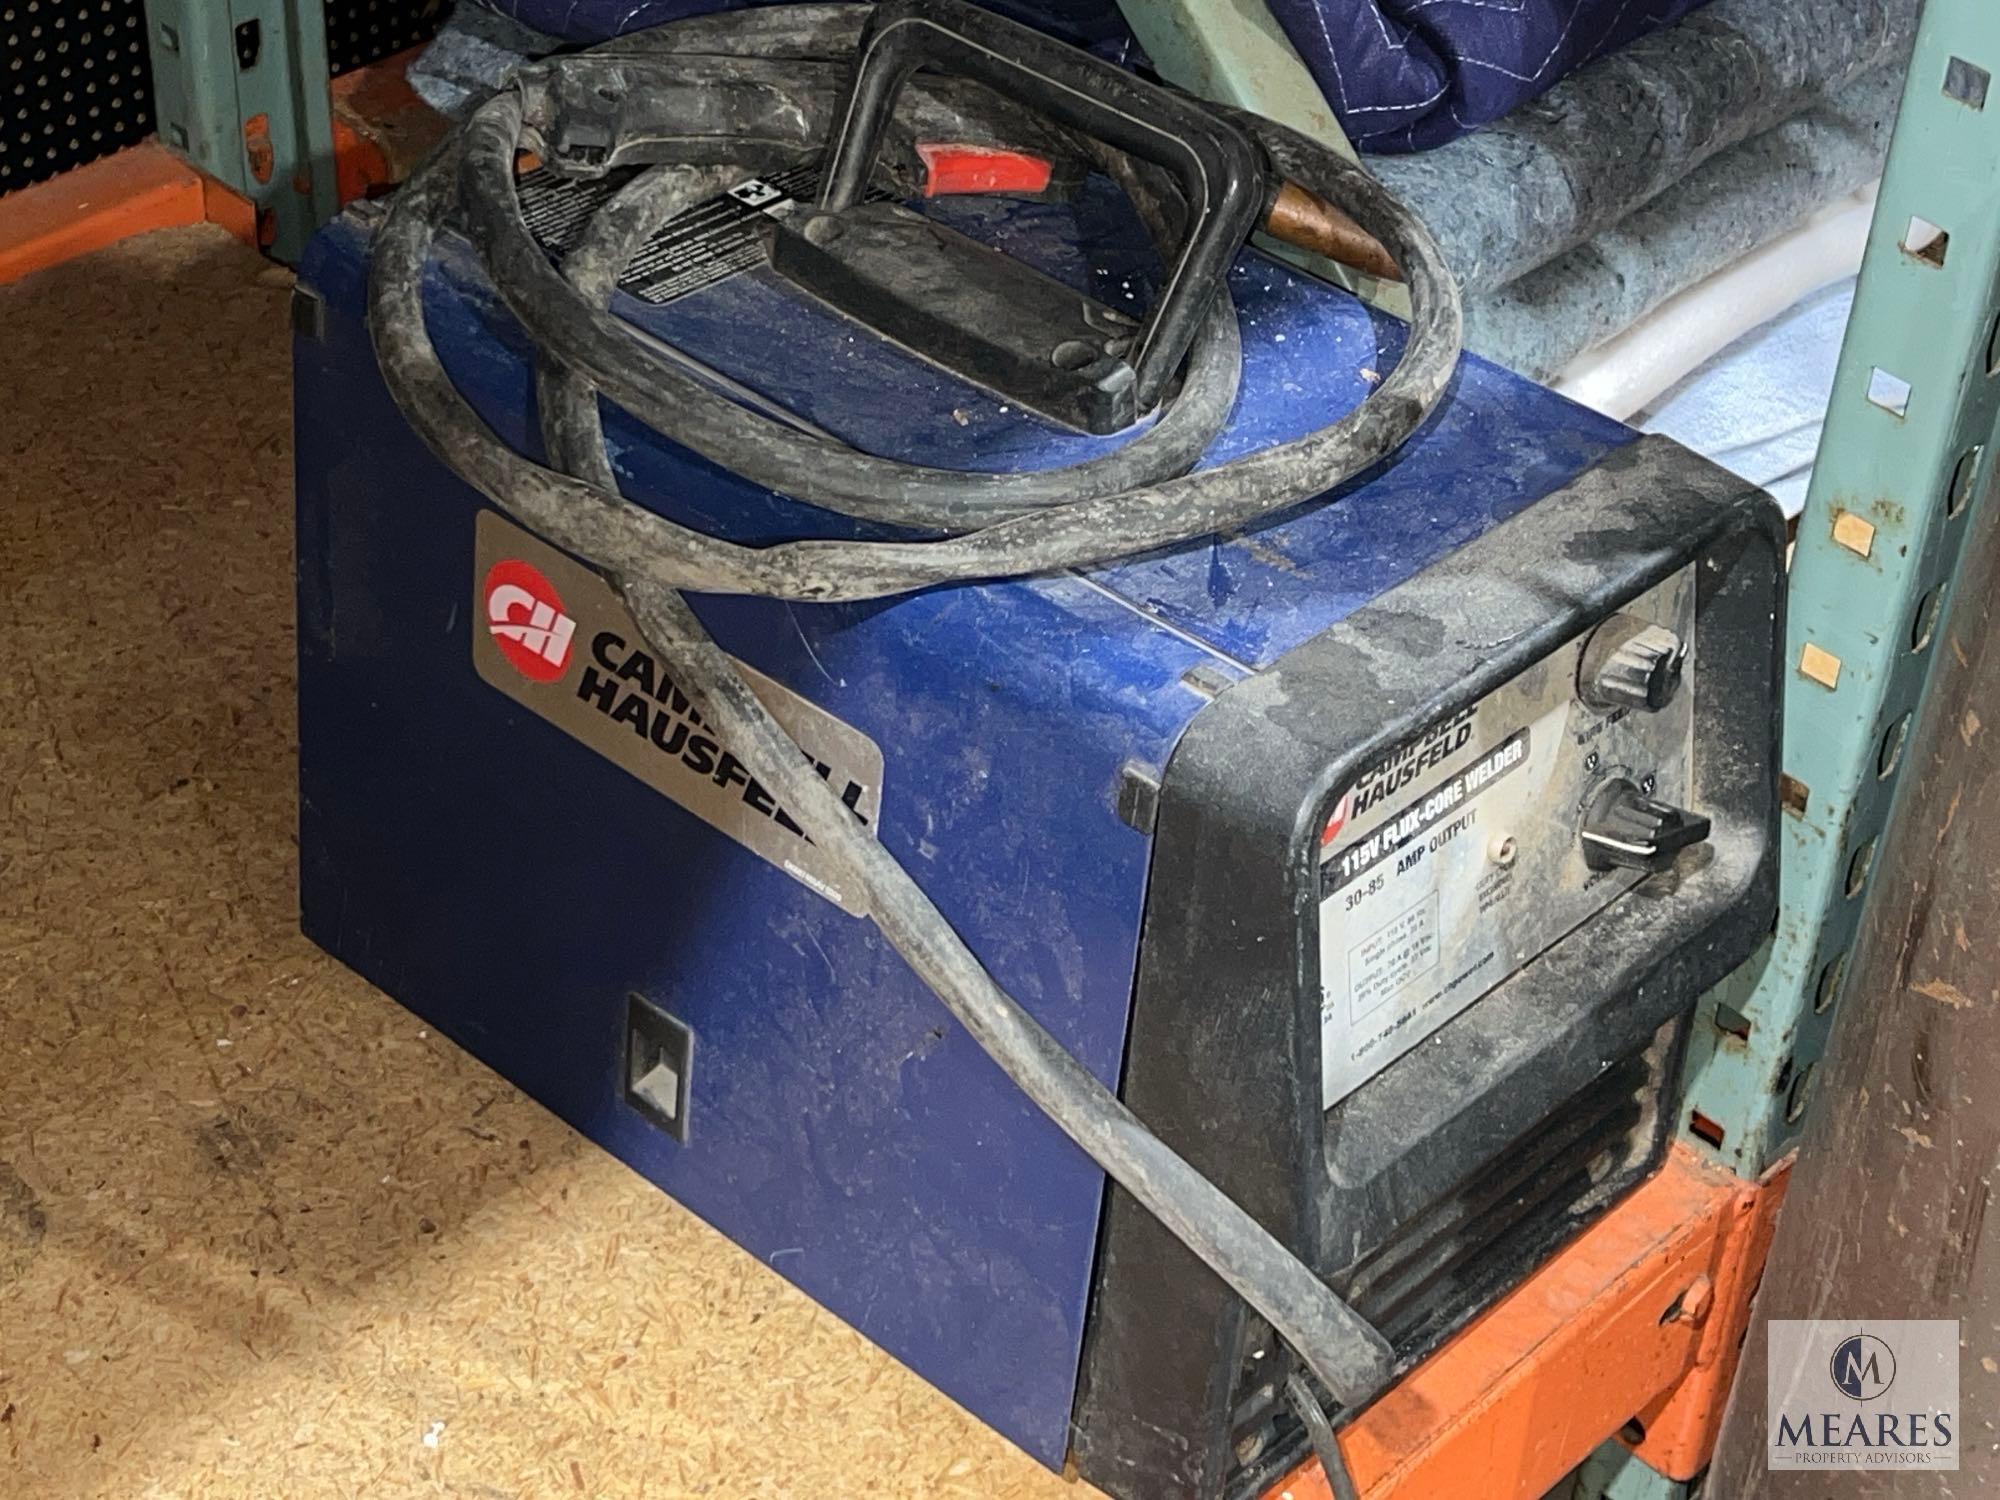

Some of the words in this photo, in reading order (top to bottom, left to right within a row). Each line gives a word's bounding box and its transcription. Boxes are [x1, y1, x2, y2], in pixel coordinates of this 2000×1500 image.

[1341, 838, 1381, 877] 115V
[1383, 779, 1463, 851] FLUX-CORE
[1465, 739, 1523, 793] WELDER
[1351, 722, 1472, 820] HAUSFELD
[1345, 873, 1385, 912] 30-85
[1396, 845, 1426, 877] AMP
[1429, 808, 1478, 854] OUTPUT
